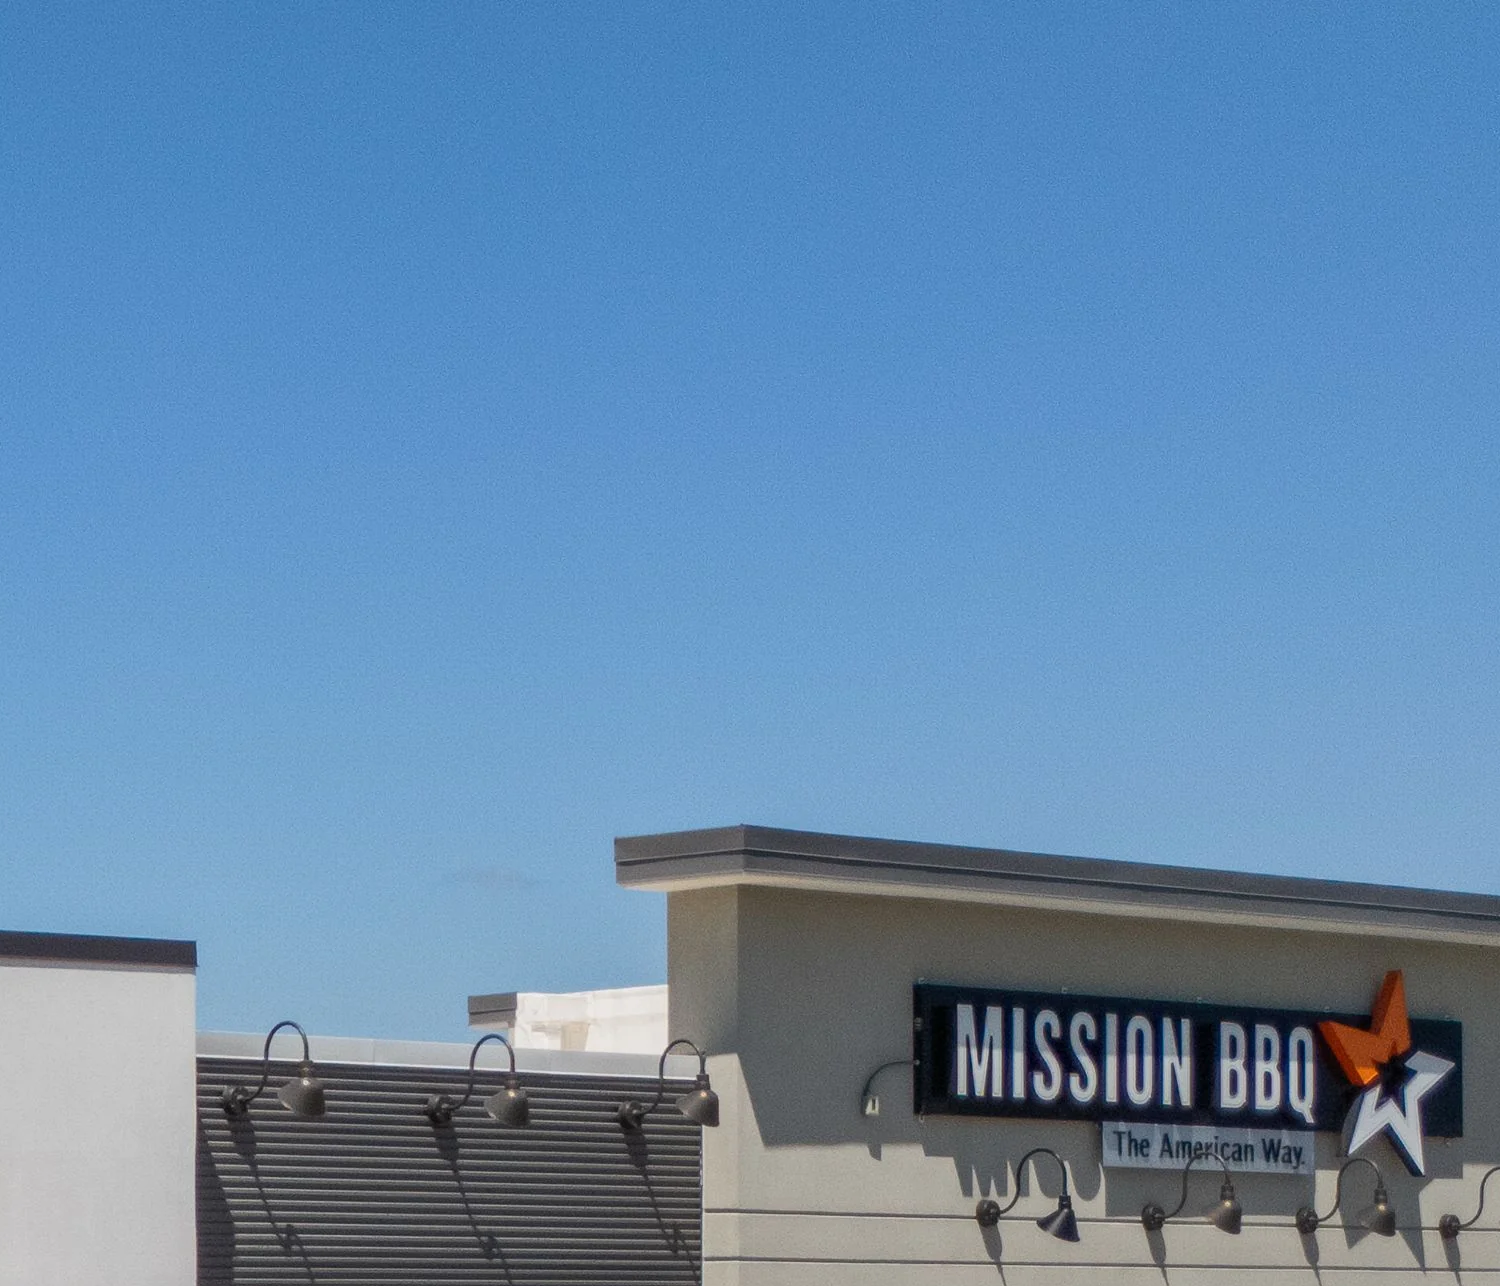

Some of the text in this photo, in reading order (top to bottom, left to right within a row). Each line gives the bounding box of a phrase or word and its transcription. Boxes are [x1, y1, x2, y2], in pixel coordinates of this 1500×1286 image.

[955, 1003, 1318, 1123] MISSION BBQ
[1113, 1130, 1306, 1170] The American Way.
